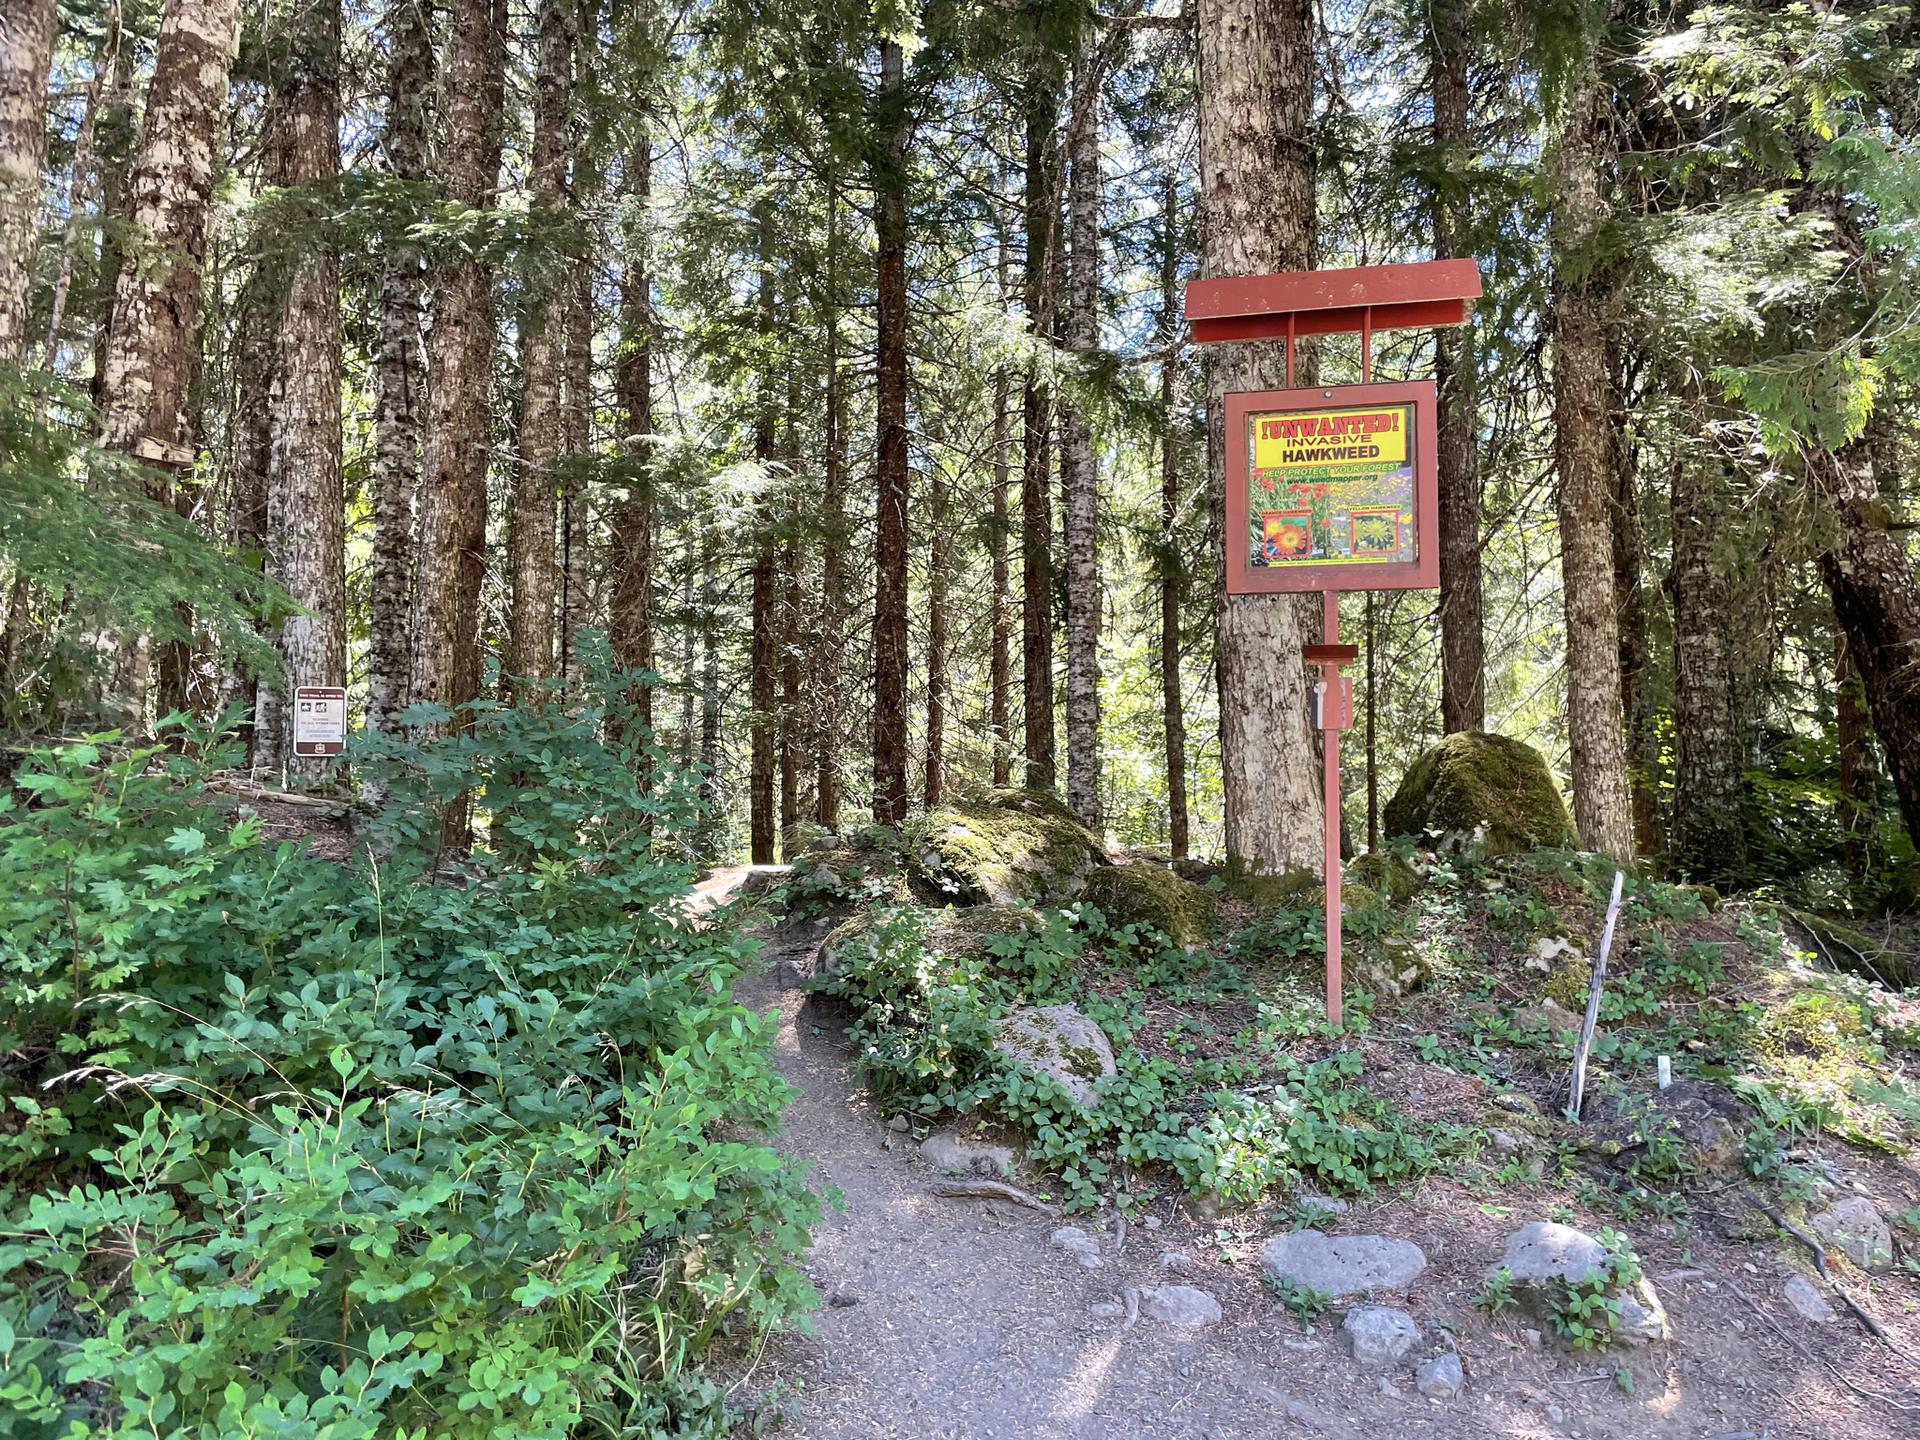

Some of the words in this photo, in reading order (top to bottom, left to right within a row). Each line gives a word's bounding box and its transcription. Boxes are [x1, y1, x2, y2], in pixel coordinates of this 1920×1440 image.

[1261, 413, 1399, 440] !UNWANTED!
[1287, 434, 1372, 447] INVASIVE
[1282, 445, 1380, 463] HAWKWEED
[1262, 469, 1285, 478] HELP
[1287, 466, 1329, 476] PROTECT
[1331, 464, 1361, 474] YOUR
[1362, 462, 1401, 472] FOREST
[1286, 474, 1378, 485] www.weedmapper.org
